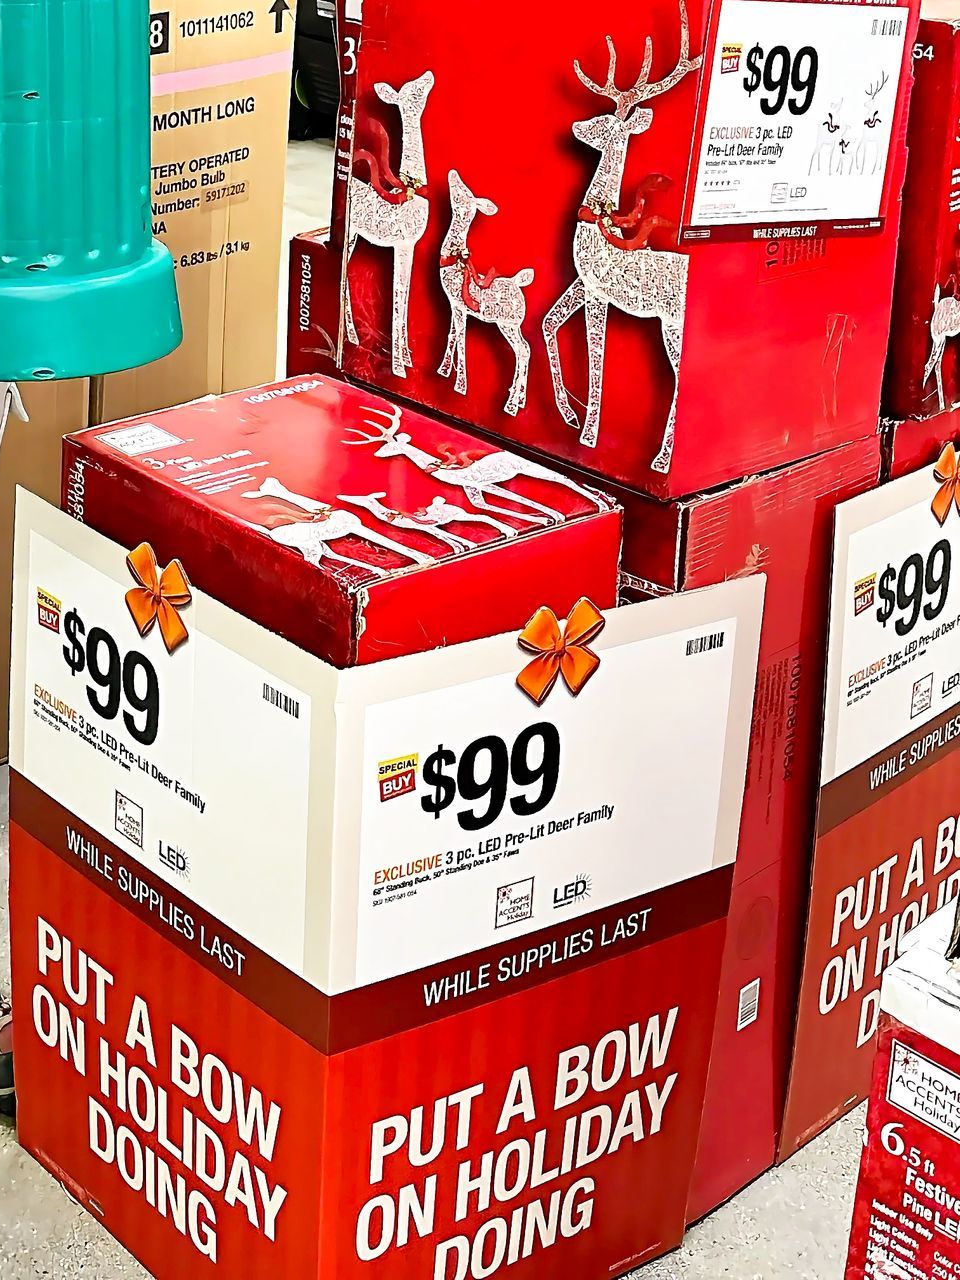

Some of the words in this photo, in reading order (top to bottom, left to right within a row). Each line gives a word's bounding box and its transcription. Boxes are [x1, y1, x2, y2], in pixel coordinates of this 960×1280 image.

[179, 11, 255, 38] 1011141062
[153, 105, 212, 132] MONTH
[217, 96, 255, 121] LONG
[743, 42, 819, 116] $99
[189, 147, 250, 173] OPERATED
[707, 144, 736, 157] Pre-Lit
[736, 145, 755, 156] Deer
[758, 144, 784, 159] Family
[710, 126, 754, 140] EXCLUSIVE
[777, 126, 793, 140] LED
[155, 179, 198, 196] Jumbo
[201, 171, 225, 186] Bulb
[205, 183, 246, 203] 59171202
[180, 251, 205, 268] 6.83
[298, 254, 312, 333] 1007581054
[876, 538, 951, 637] $99
[62, 607, 160, 746] $99
[34, 684, 78, 724] EXCLUSIVE
[101, 730, 117, 751] LED
[119, 742, 150, 775] Pre-Lit
[151, 764, 173, 788] Deer
[175, 780, 206, 814] Family
[378, 758, 417, 776] SPECIAL
[381, 773, 412, 797] BUY
[420, 720, 561, 832] $99
[373, 853, 442, 885] EXCLUSIVE
[478, 836, 501, 856] LED
[505, 824, 545, 848] Pre-Lit
[548, 816, 575, 836] Deer
[577, 804, 615, 828] Family
[65, 825, 114, 882] WHILE
[117, 866, 195, 940] SUPPLIES
[200, 925, 245, 977] LAST
[830, 854, 898, 948] PUT
[901, 837, 924, 899] A
[423, 963, 490, 1007] WHILE
[497, 928, 595, 983] SUPPLIES
[600, 908, 652, 947] LAST
[818, 945, 867, 1017] ON
[36, 915, 114, 1026] PUT
[125, 994, 158, 1068] A
[170, 1022, 283, 1165] BOW
[31, 984, 87, 1079] ON
[99, 1036, 288, 1244] HOLIDAY
[368, 1082, 483, 1186] PUT
[495, 1065, 538, 1136] A
[553, 1005, 680, 1111] BOW
[913, 1096, 960, 1133] Holiday
[87, 1095, 219, 1266] DOING
[355, 1177, 436, 1264] ON
[455, 1071, 679, 1224] HOLIDAY
[880, 1122, 921, 1167] 6.5
[924, 1159, 935, 1176] ft
[433, 1174, 596, 1280] DOING
[899, 1213, 913, 1228] Use
[915, 1224, 933, 1241] Only
[902, 1192, 932, 1220] Pine
[905, 1166, 960, 1216] Festive
